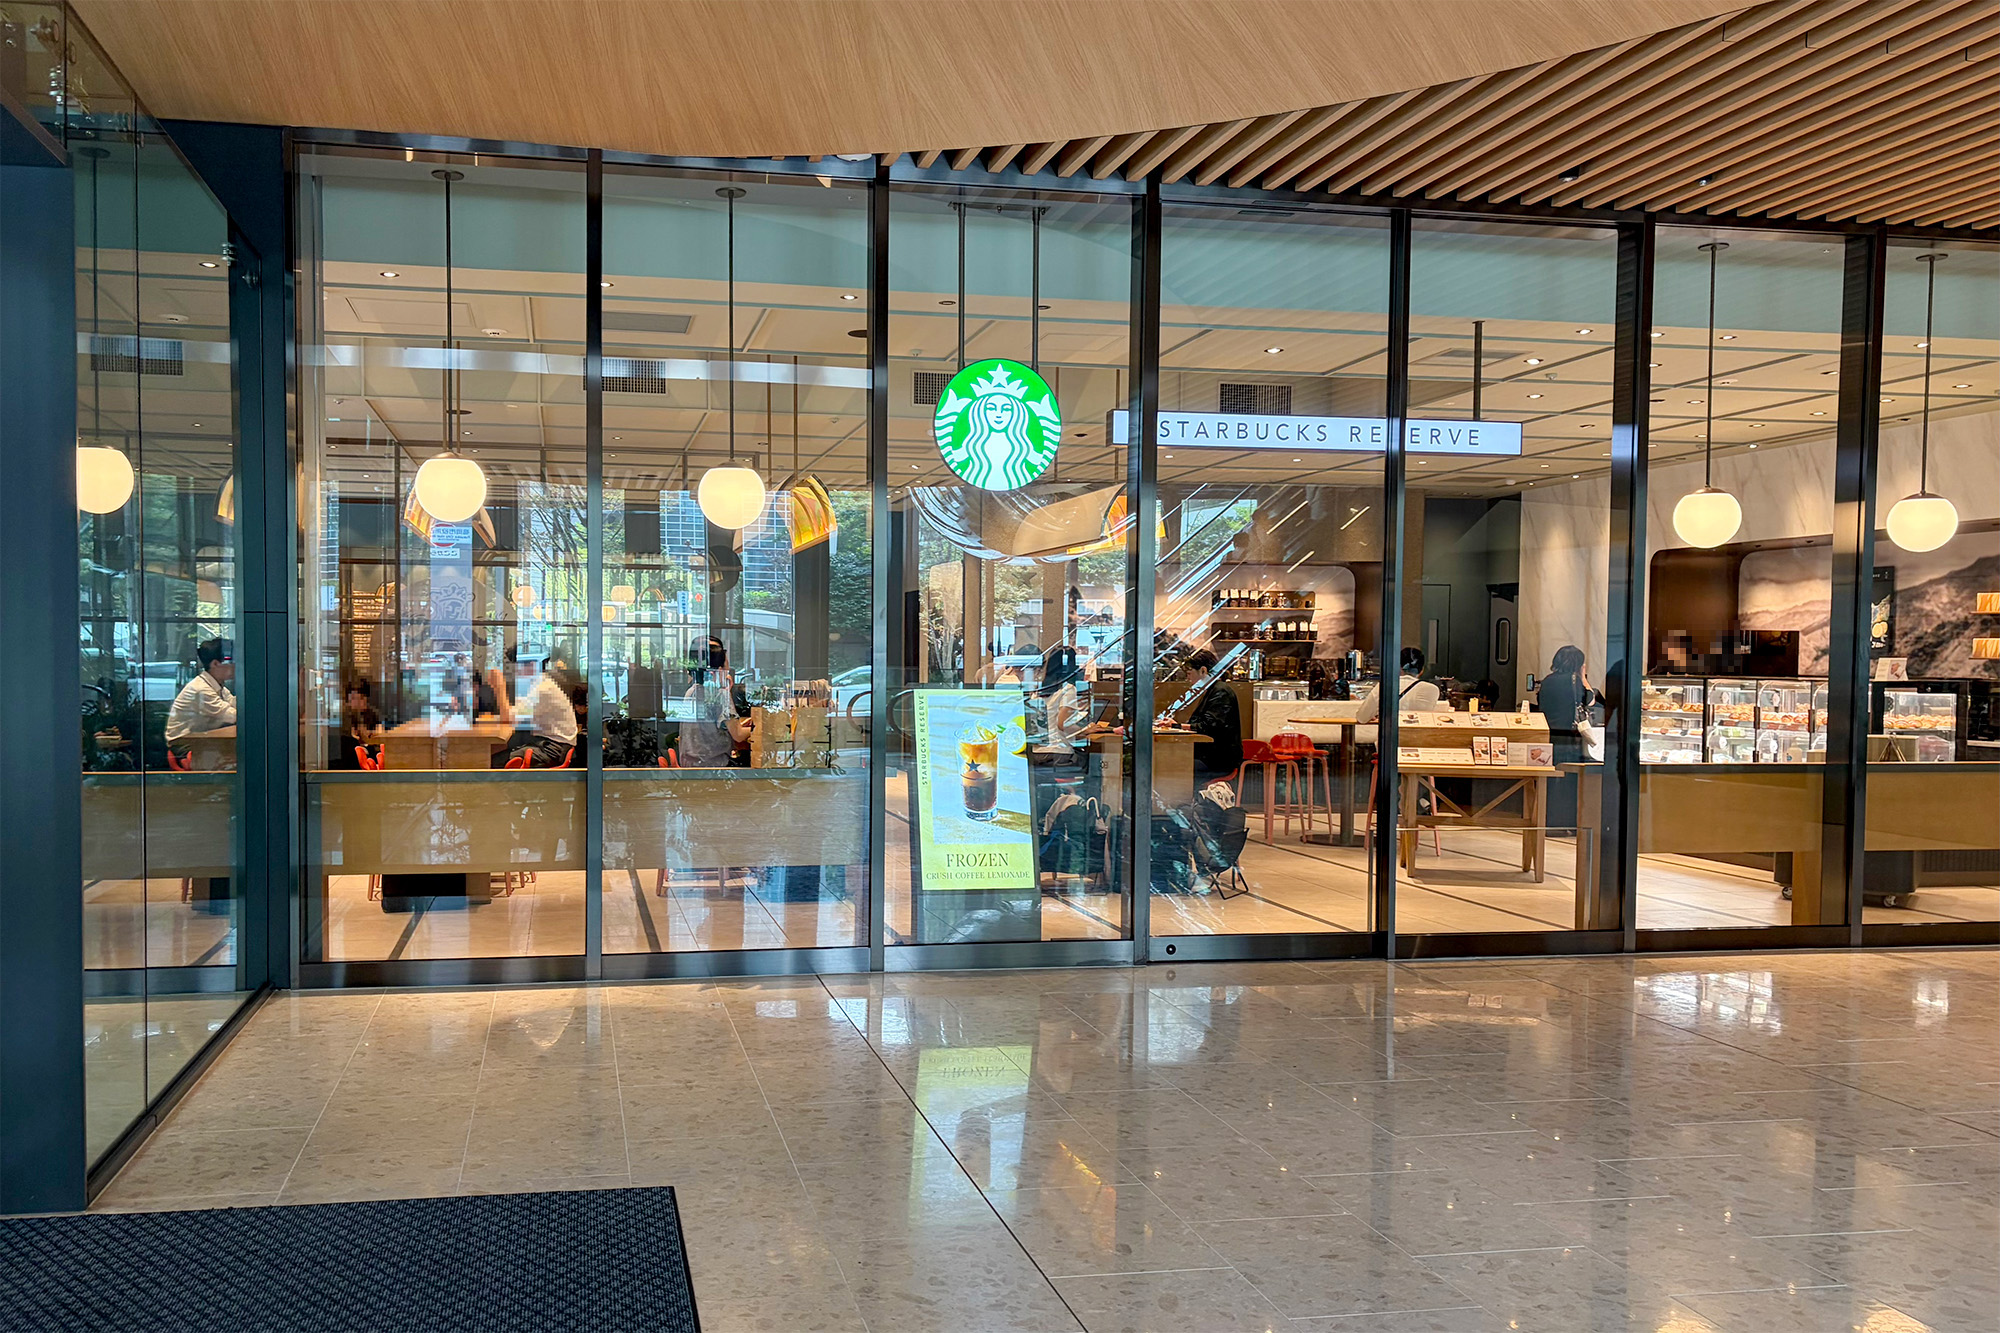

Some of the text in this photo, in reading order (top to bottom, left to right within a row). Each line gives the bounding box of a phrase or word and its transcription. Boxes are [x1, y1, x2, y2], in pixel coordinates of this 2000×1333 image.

[1159, 420, 1479, 446] STARBUCKS REERVE
[918, 695, 928, 785] STARBUCKS RESERVE
[946, 853, 1009, 868] FROZEN
[926, 871, 1030, 880] CRUSH COFFEE LEMONADE
